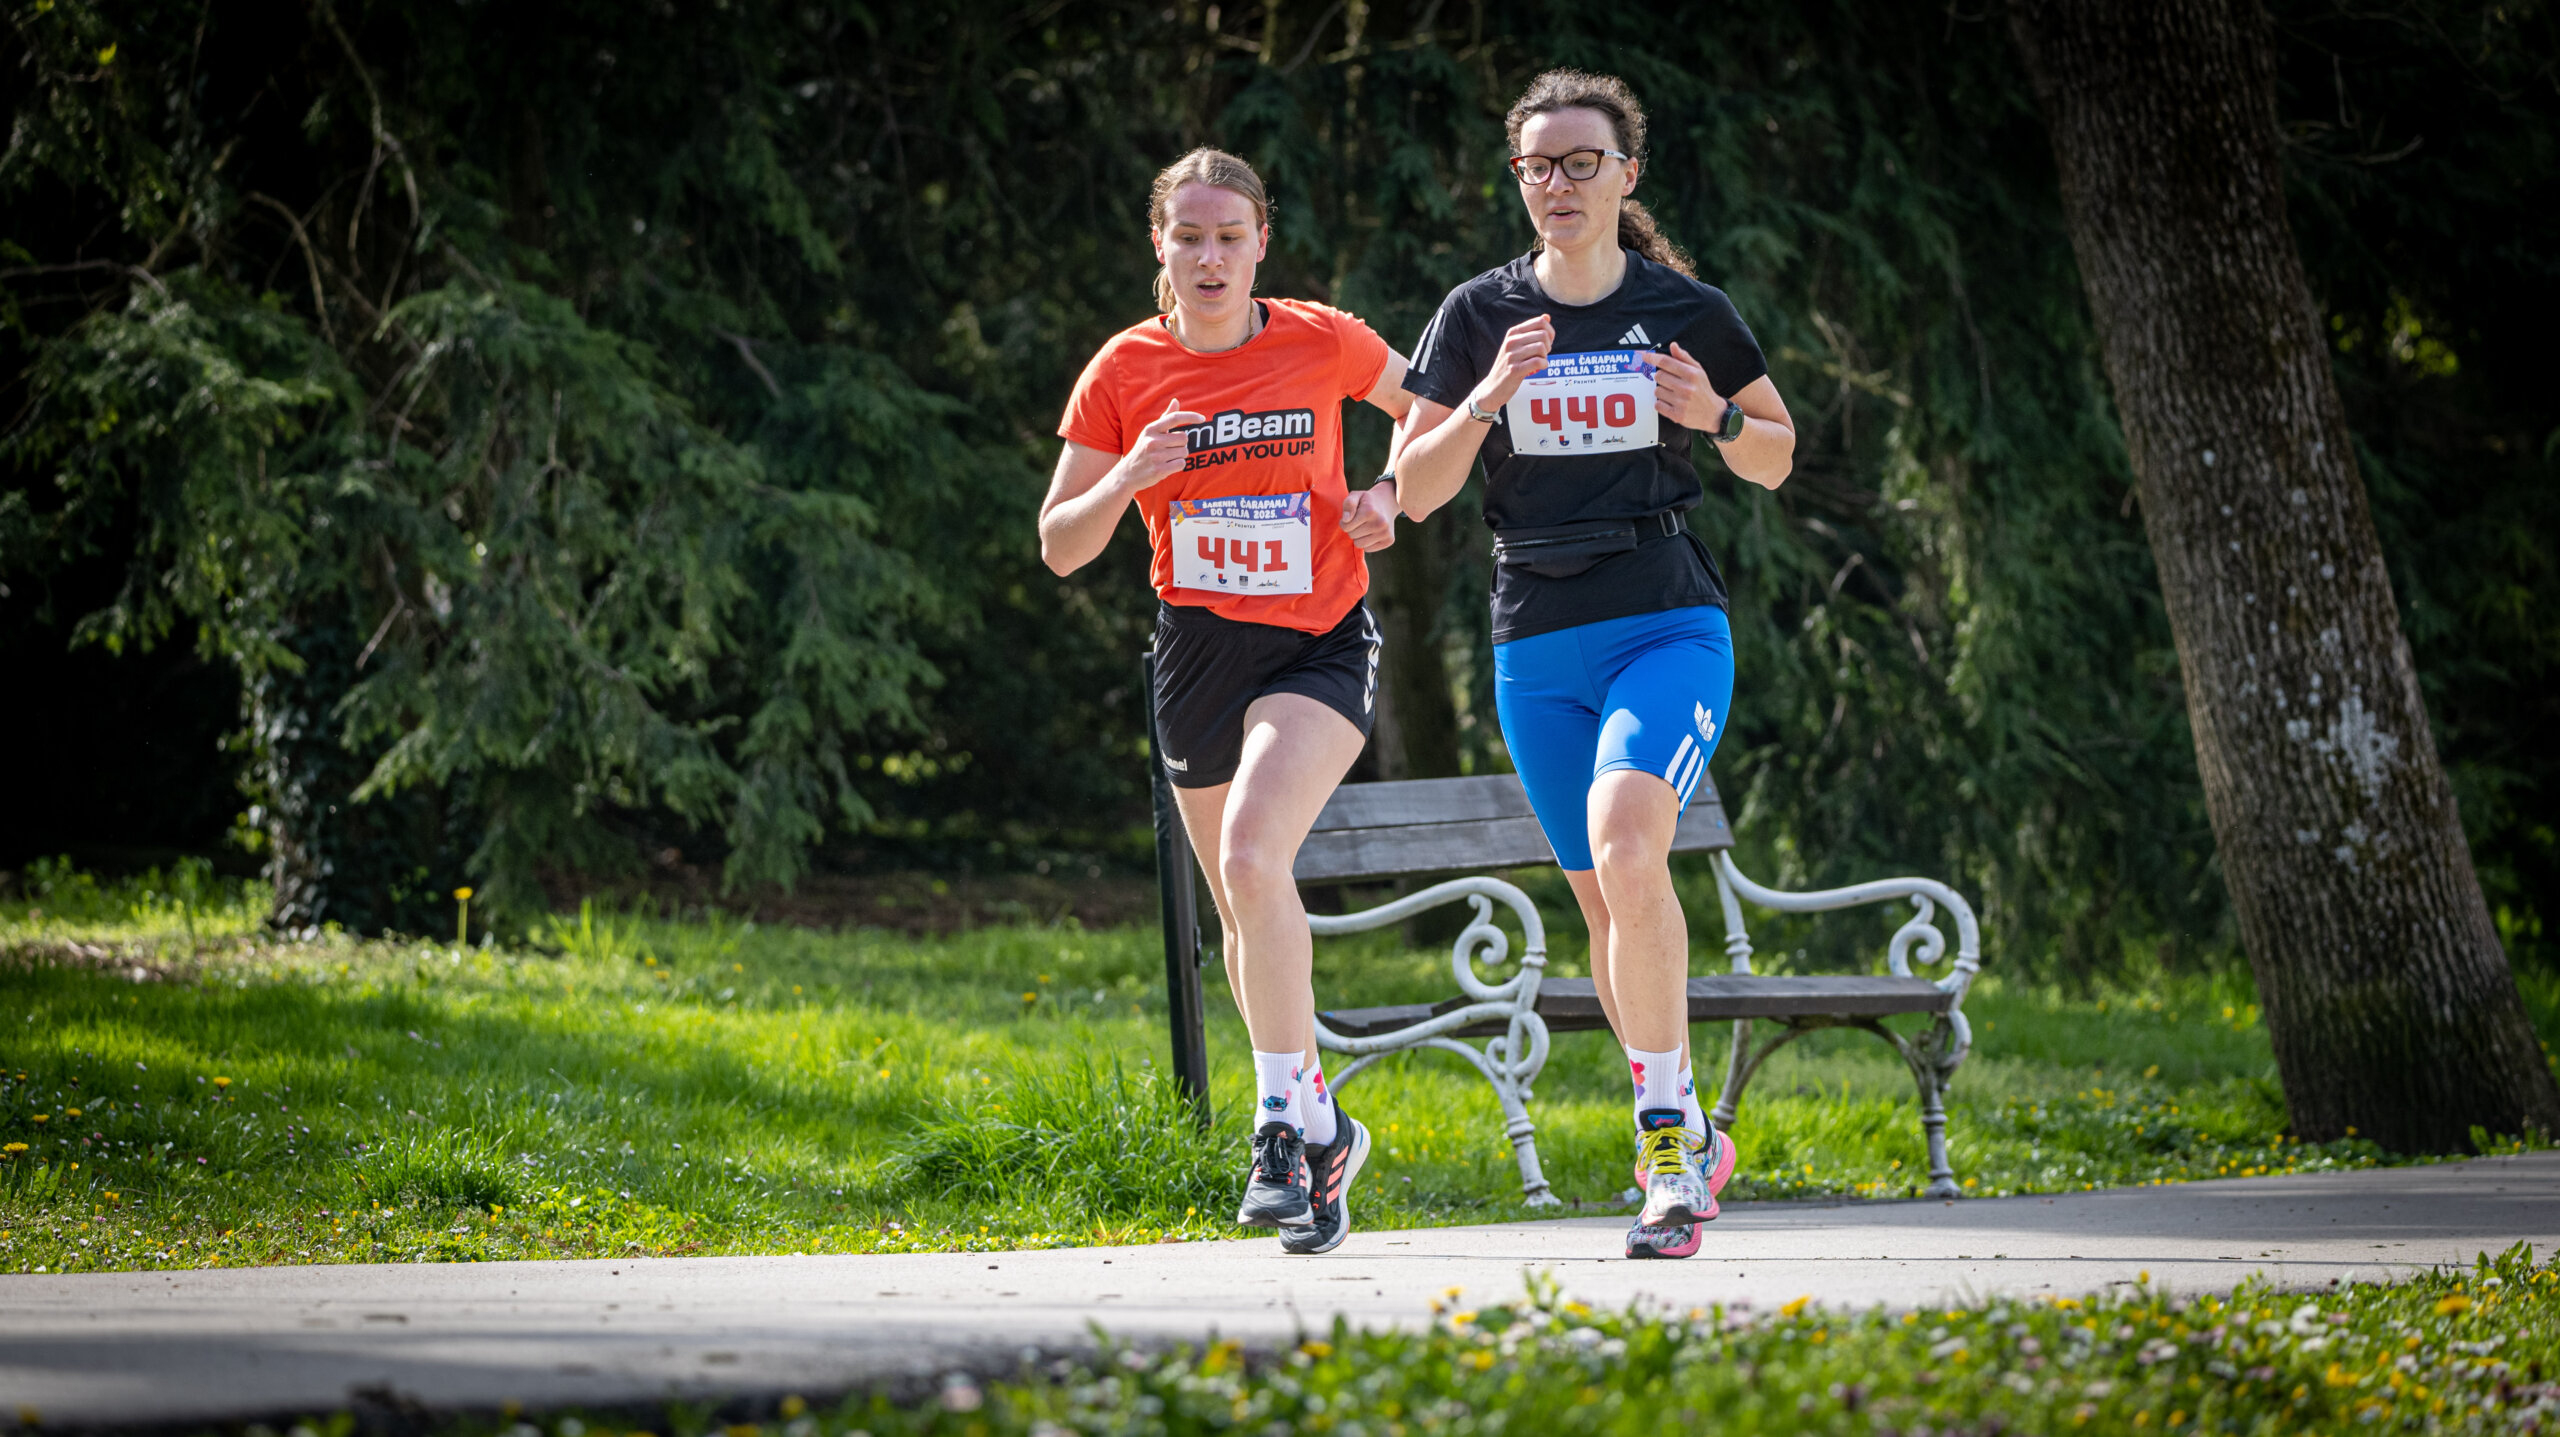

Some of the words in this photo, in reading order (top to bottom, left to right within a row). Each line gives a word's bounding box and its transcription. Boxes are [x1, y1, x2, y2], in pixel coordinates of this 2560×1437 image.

[1547, 367, 1561, 376] DO
[1564, 365, 1590, 375] CILJA
[1593, 364, 1619, 373] 2025.
[1548, 358, 1575, 367] RENIM
[1578, 354, 1630, 365] ČARAPAMA
[1530, 393, 1636, 431] 440
[1184, 412, 1312, 448] mBeam
[1183, 448, 1237, 472] BEAM
[1241, 442, 1283, 460] YOU
[1287, 440, 1315, 456] UP!
[1210, 508, 1223, 516] DO
[1226, 509, 1250, 518] CILJA
[1253, 509, 1277, 519] 2025.
[1240, 497, 1287, 509] ČARAPAMA
[1198, 536, 1288, 572] 441
